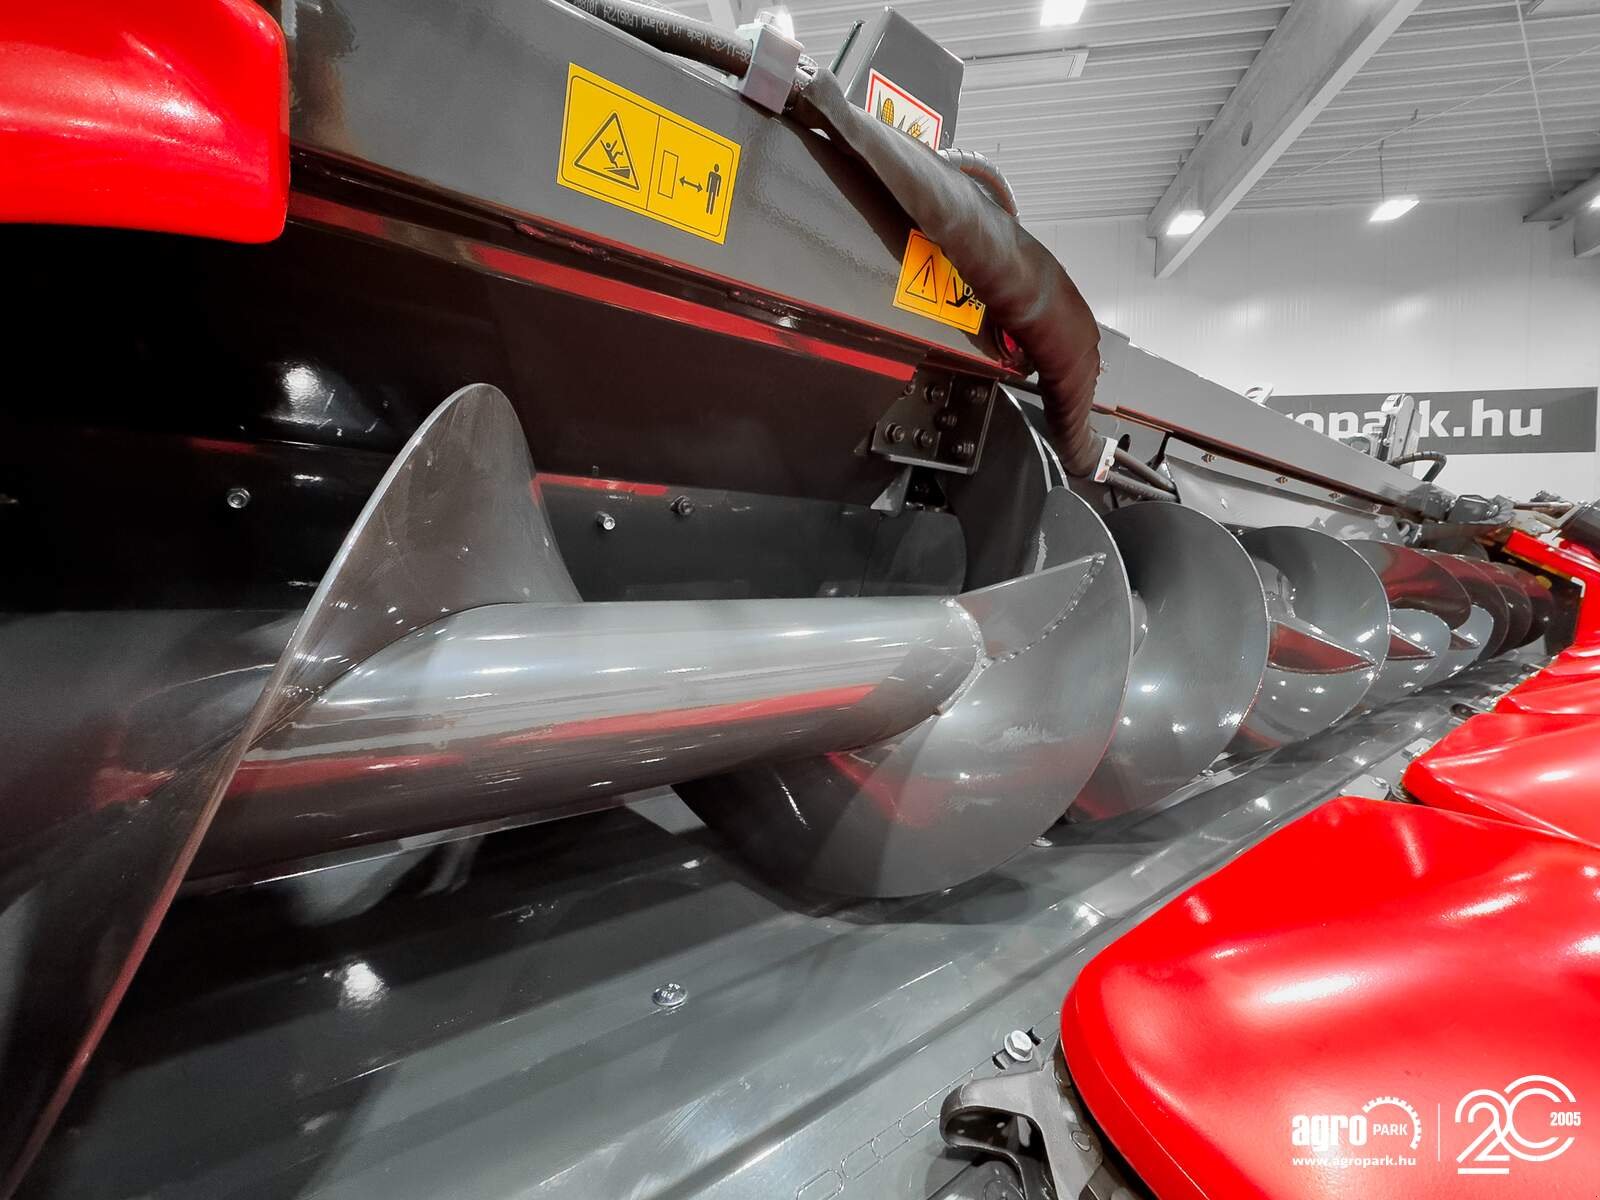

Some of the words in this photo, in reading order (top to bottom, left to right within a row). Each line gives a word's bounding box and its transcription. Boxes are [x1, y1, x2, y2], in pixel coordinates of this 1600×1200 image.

[641, 15, 669, 36] Poland
[672, 24, 682, 38] in
[687, 28, 708, 47] Made
[1285, 399, 1543, 439] opak.hu
